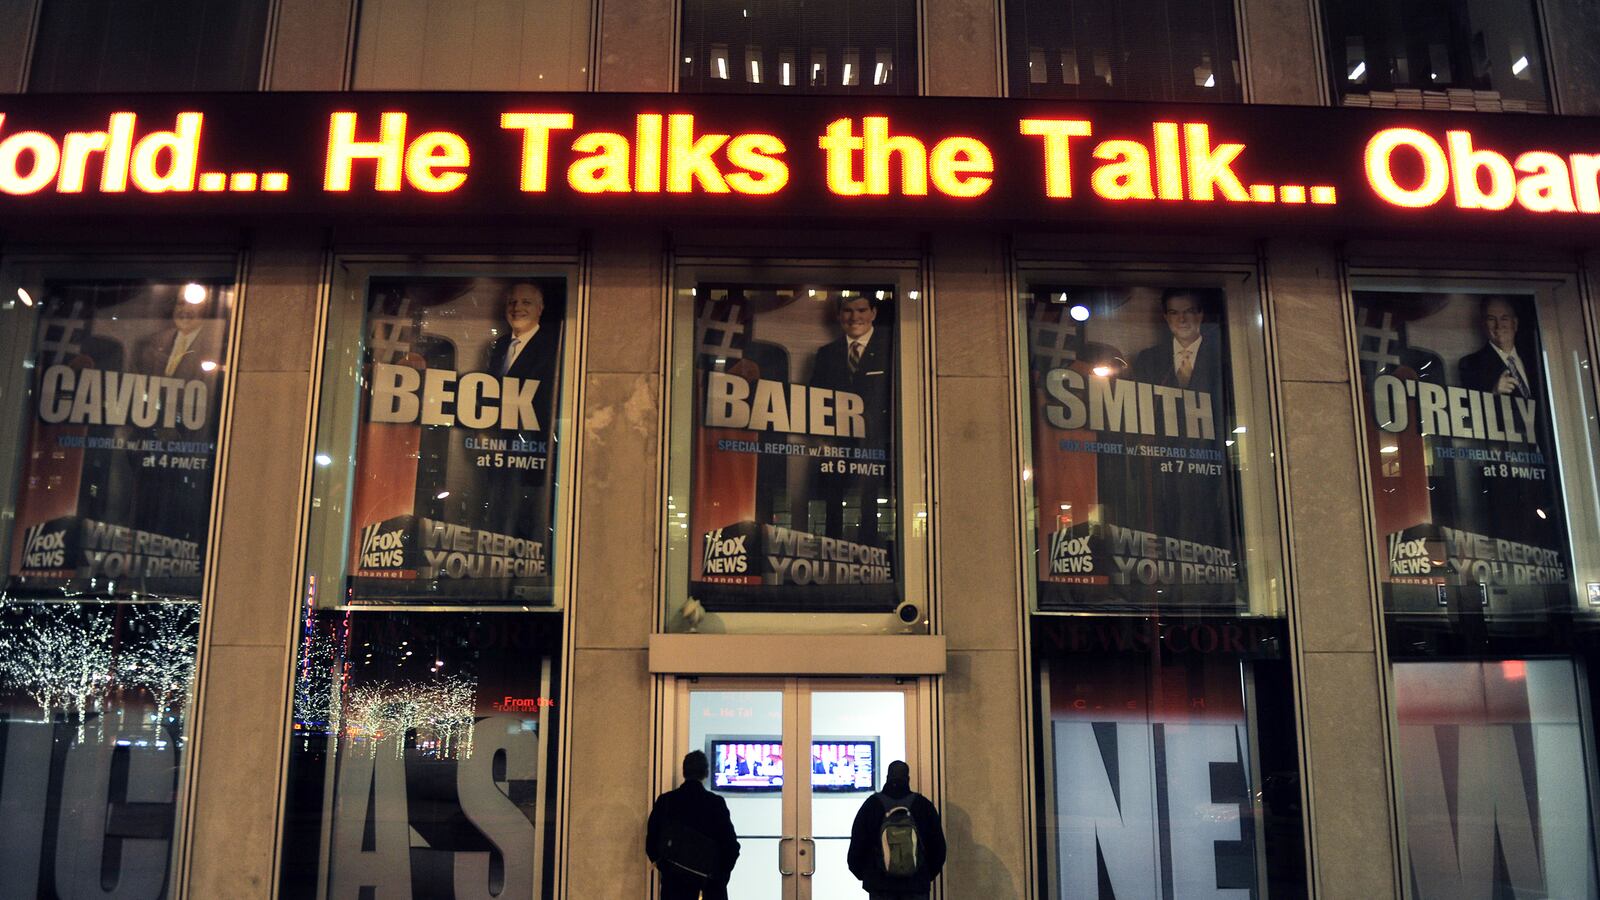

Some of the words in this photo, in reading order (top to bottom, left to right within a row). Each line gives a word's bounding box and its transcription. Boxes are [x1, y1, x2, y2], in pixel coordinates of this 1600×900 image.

[0, 111, 289, 195] orld...
[322, 111, 471, 192] He
[500, 112, 789, 195] Talks
[818, 115, 994, 197] the
[1018, 118, 1337, 204] Talk...
[39, 364, 208, 431] CAVUTO
[370, 362, 541, 432] BECK
[705, 371, 866, 438] BAIER
[1045, 368, 1215, 440] SMITH
[1373, 374, 1537, 445] O'REILLY
[464, 437, 508, 451] GLENN
[511, 439, 547, 453] BECK
[717, 439, 762, 453] SPECIAL
[764, 442, 806, 456] REPORT
[808, 445, 822, 457] w/
[824, 446, 851, 459] BRET
[853, 447, 886, 461] BAIER
[1126, 445, 1139, 457] w/
[1140, 445, 1187, 459] SHEPARD
[1188, 447, 1222, 461] SMITH
[142, 454, 156, 468] at
[158, 453, 169, 468] 4
[170, 456, 208, 471] PM/ET
[476, 453, 491, 467] at
[494, 452, 504, 468] 5
[507, 455, 547, 470] PM/ET
[821, 461, 834, 474] at
[837, 460, 846, 474] 6
[850, 462, 886, 477] PM/ET
[1160, 461, 1173, 474] at
[1176, 460, 1185, 474] 7
[1188, 463, 1223, 477] PM/ET
[1504, 451, 1545, 465] FACTOR
[1483, 464, 1497, 477] at
[1499, 463, 1509, 478] 8
[1511, 465, 1548, 481] PM/ET
[371, 528, 405, 552] FOX
[423, 518, 475, 553] WE
[714, 534, 748, 558] FOX
[765, 523, 819, 560] WE
[821, 535, 891, 566] REPORT.
[1060, 535, 1093, 558] FOX
[1109, 523, 1162, 560] WE
[363, 550, 404, 568] NEWS
[1399, 536, 1430, 559] FOX
[423, 550, 486, 579] YOU
[706, 555, 749, 575] NEWS
[767, 556, 831, 586] YOU
[1053, 554, 1095, 574] NEWS
[1113, 555, 1175, 586] YOU
[1393, 556, 1432, 576] NEWS
[1450, 556, 1508, 586] YOU
